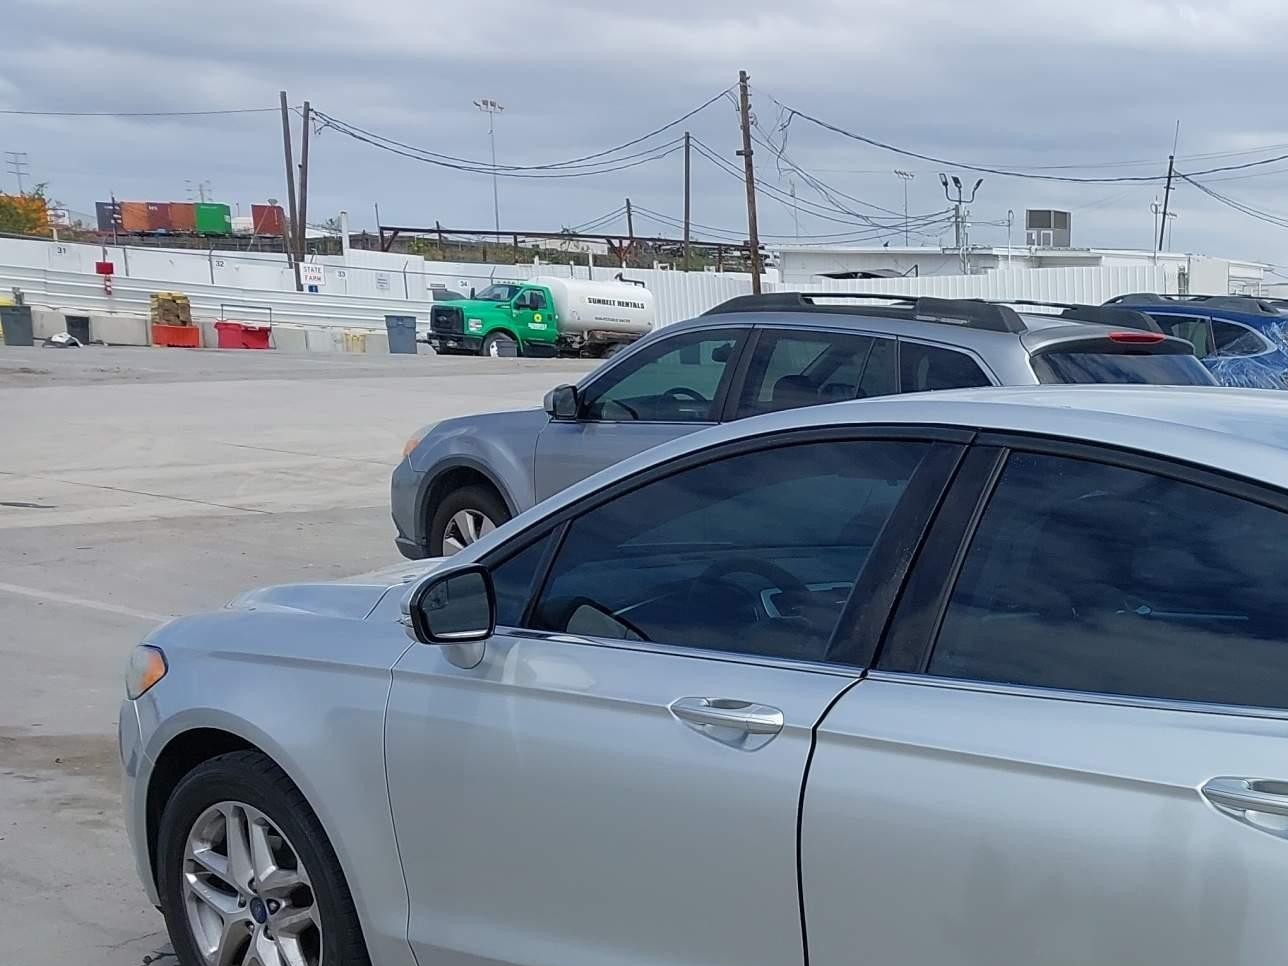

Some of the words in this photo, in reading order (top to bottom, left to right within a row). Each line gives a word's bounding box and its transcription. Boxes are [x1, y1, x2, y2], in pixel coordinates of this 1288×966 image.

[57, 247, 66, 255] 31
[215, 260, 225, 268] 32
[303, 266, 322, 274] STATE
[587, 297, 617, 307] SUNBELT
[617, 300, 645, 310] RENTALS
